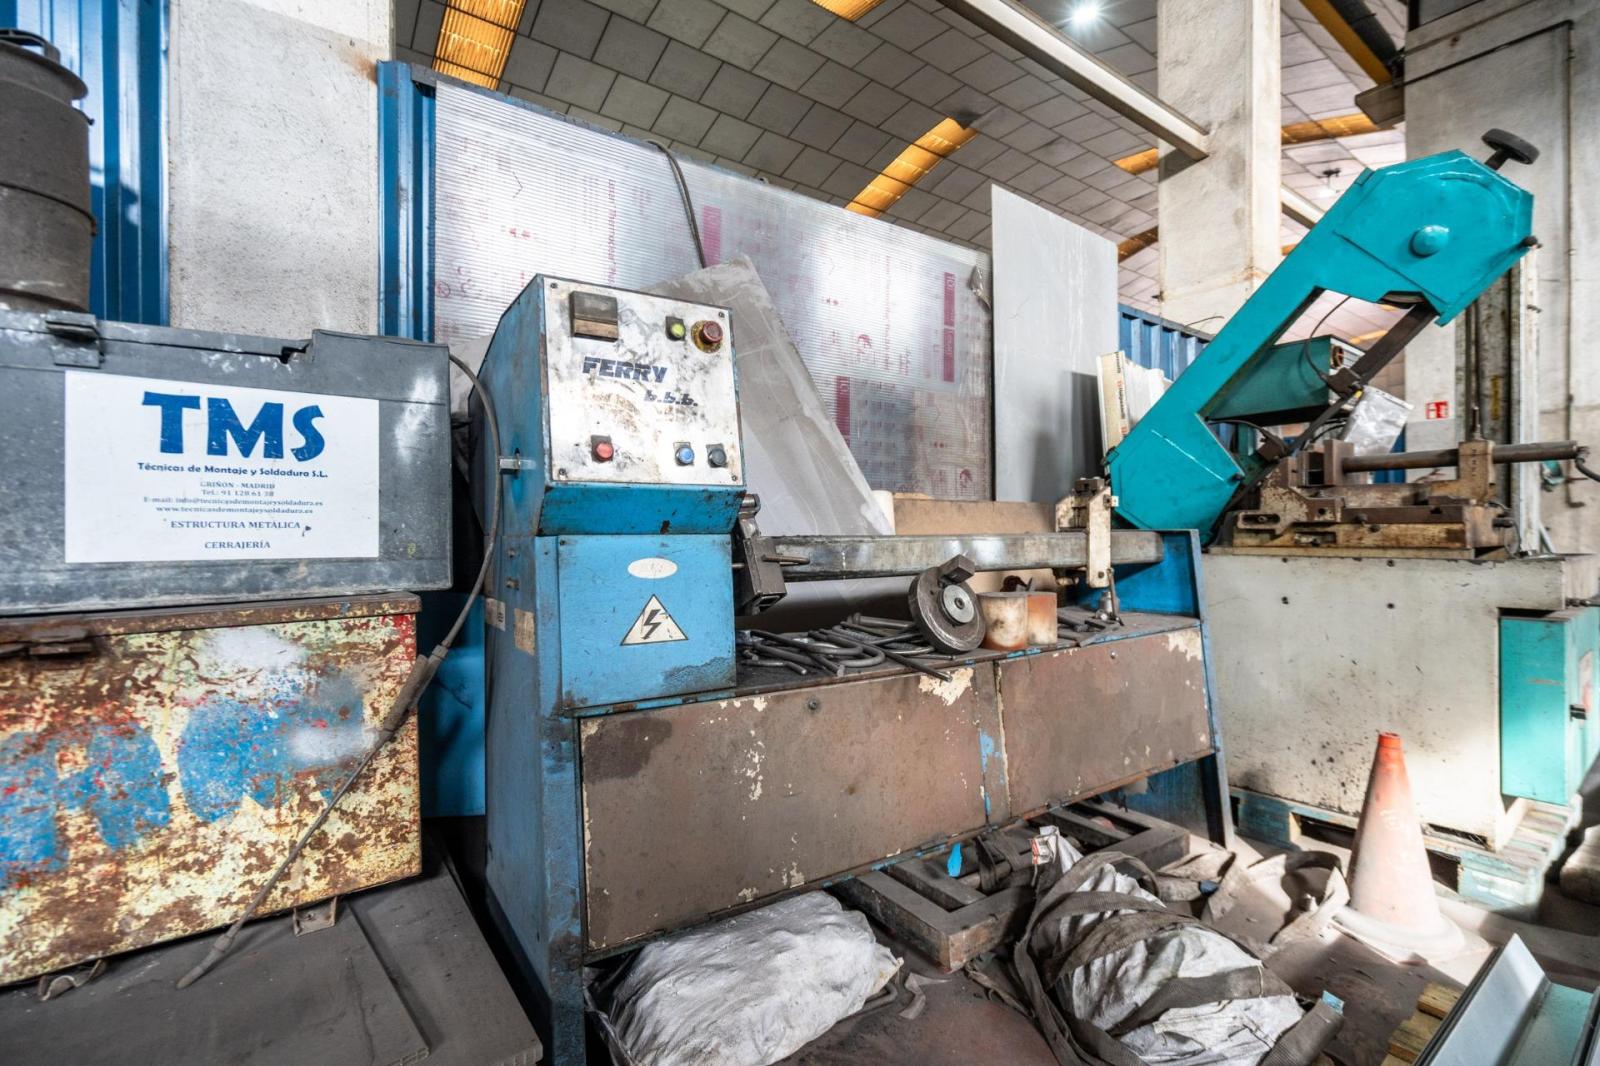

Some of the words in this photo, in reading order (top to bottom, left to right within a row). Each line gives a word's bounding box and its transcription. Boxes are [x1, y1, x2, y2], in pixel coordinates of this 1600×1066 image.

[582, 356, 668, 383] FERRY
[142, 391, 326, 462] TMS
[137, 462, 184, 472] Técnicas
[187, 464, 202, 473] de
[204, 465, 248, 475] Montaje
[250, 468, 257, 476] y
[259, 467, 309, 477] Soldadura
[312, 470, 328, 478] S.L.
[170, 520, 246, 529] ESTRUCTURA
[248, 520, 301, 529] METÁLICA
[204, 540, 271, 549] CERRAJERÍA
